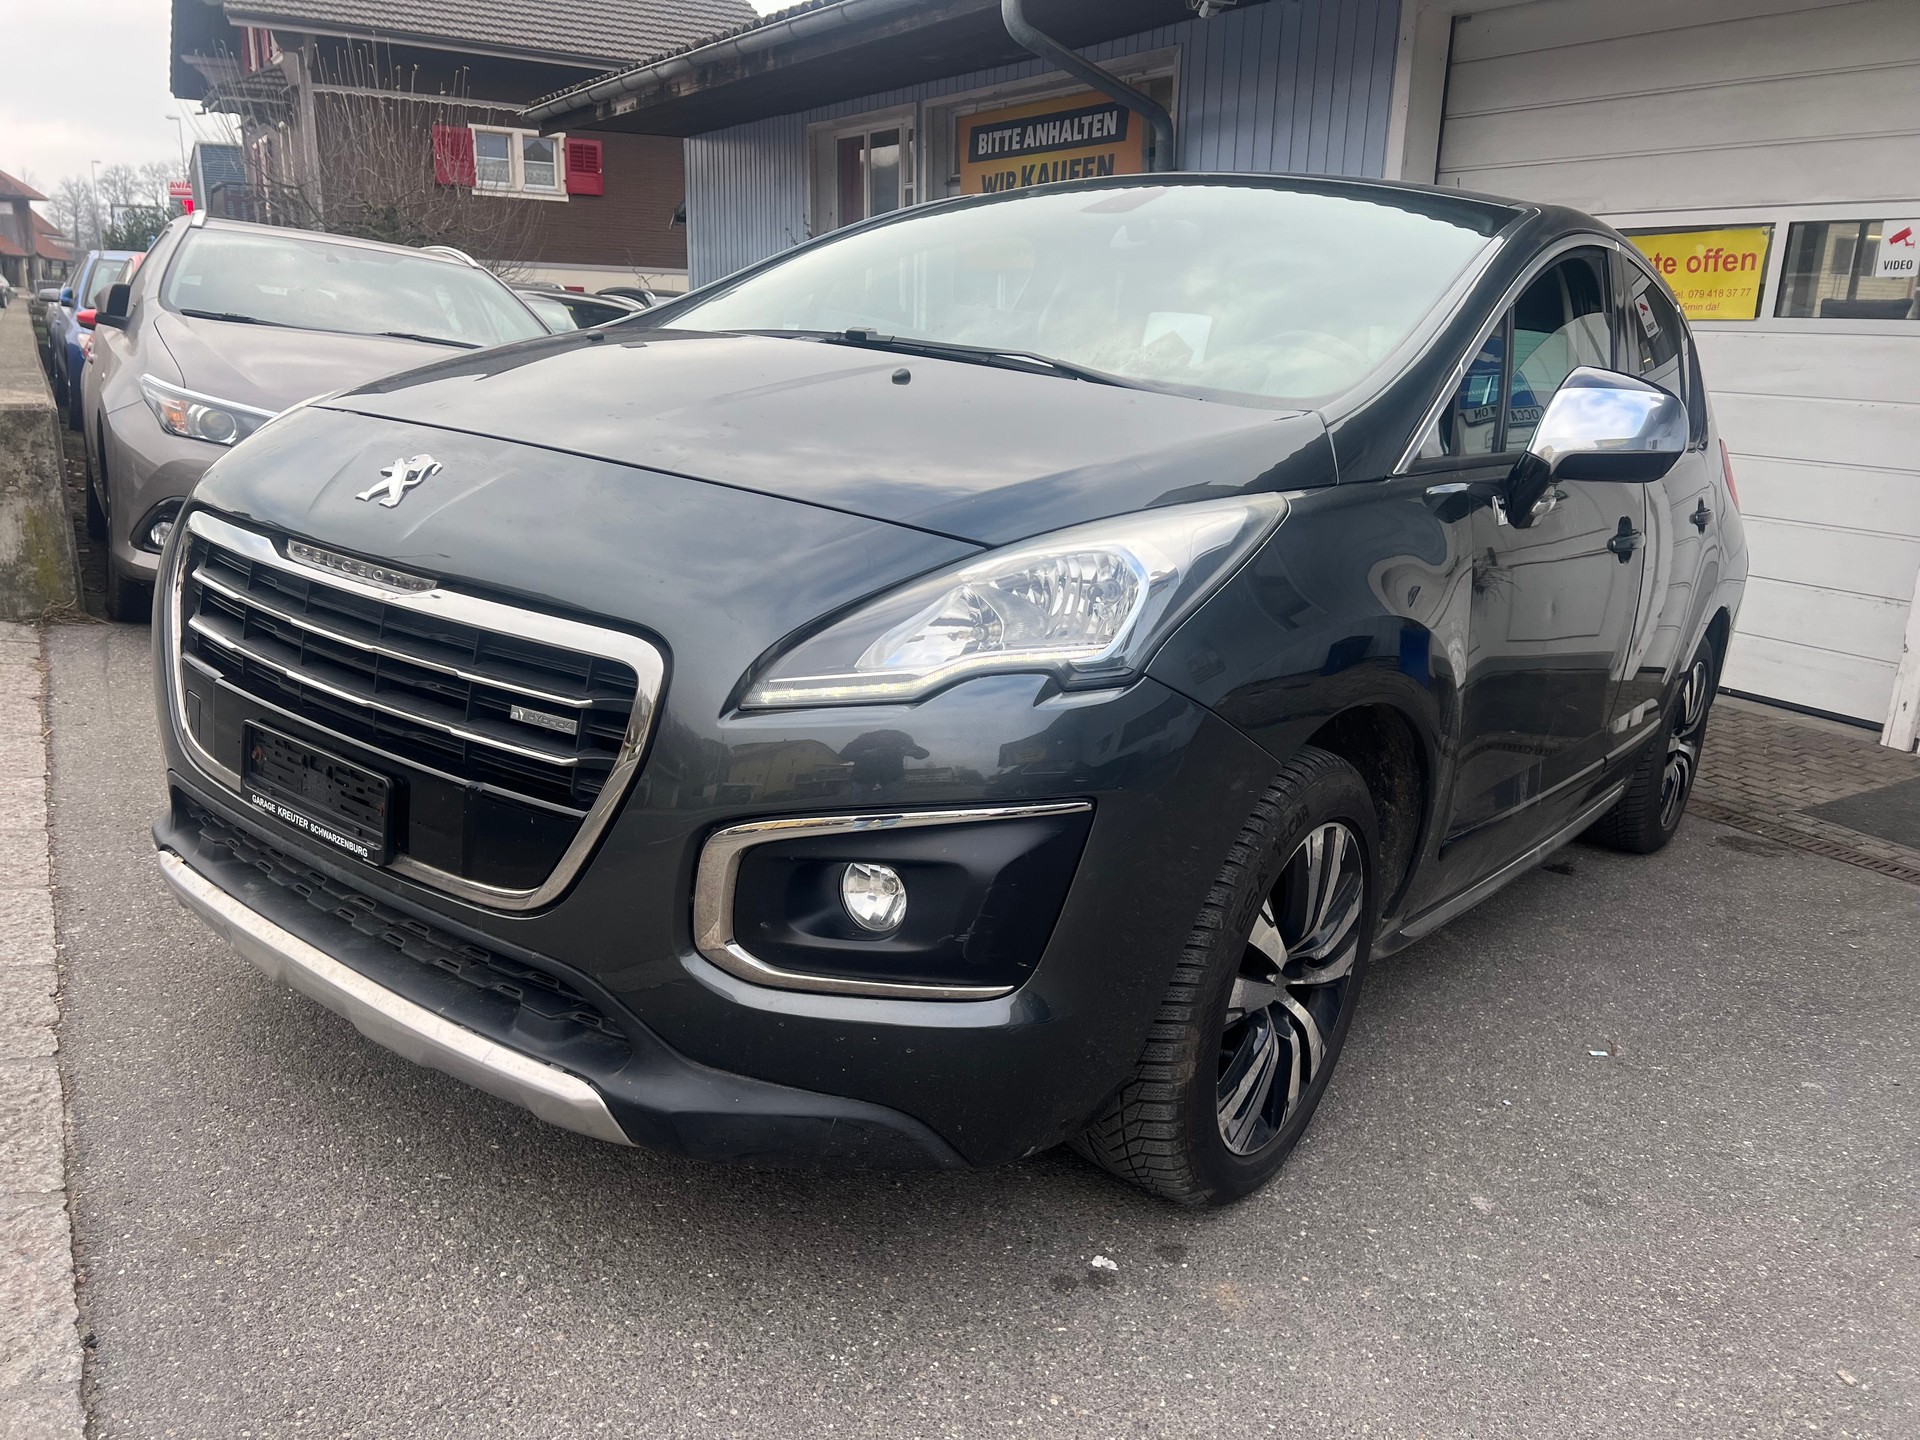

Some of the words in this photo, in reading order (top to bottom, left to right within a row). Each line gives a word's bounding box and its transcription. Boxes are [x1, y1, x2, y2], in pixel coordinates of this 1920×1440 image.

[978, 127, 1021, 155] BITTE
[1023, 110, 1118, 148] ANHALTEN
[170, 181, 191, 189] AVIA
[981, 171, 1017, 193] WIR
[1686, 247, 1757, 273] offen
[1884, 260, 1913, 270] VIDEO
[1688, 289, 1705, 299] 079
[1707, 289, 1724, 298] 418
[1726, 288, 1738, 298] 37
[1740, 288, 1752, 297] 77
[1705, 302, 1720, 311] da!
[301, 547, 401, 586] PEUGEOT
[252, 794, 276, 813] GARAGE
[277, 804, 309, 829] KREUTER
[310, 823, 368, 857] SCHWARZENBURG
